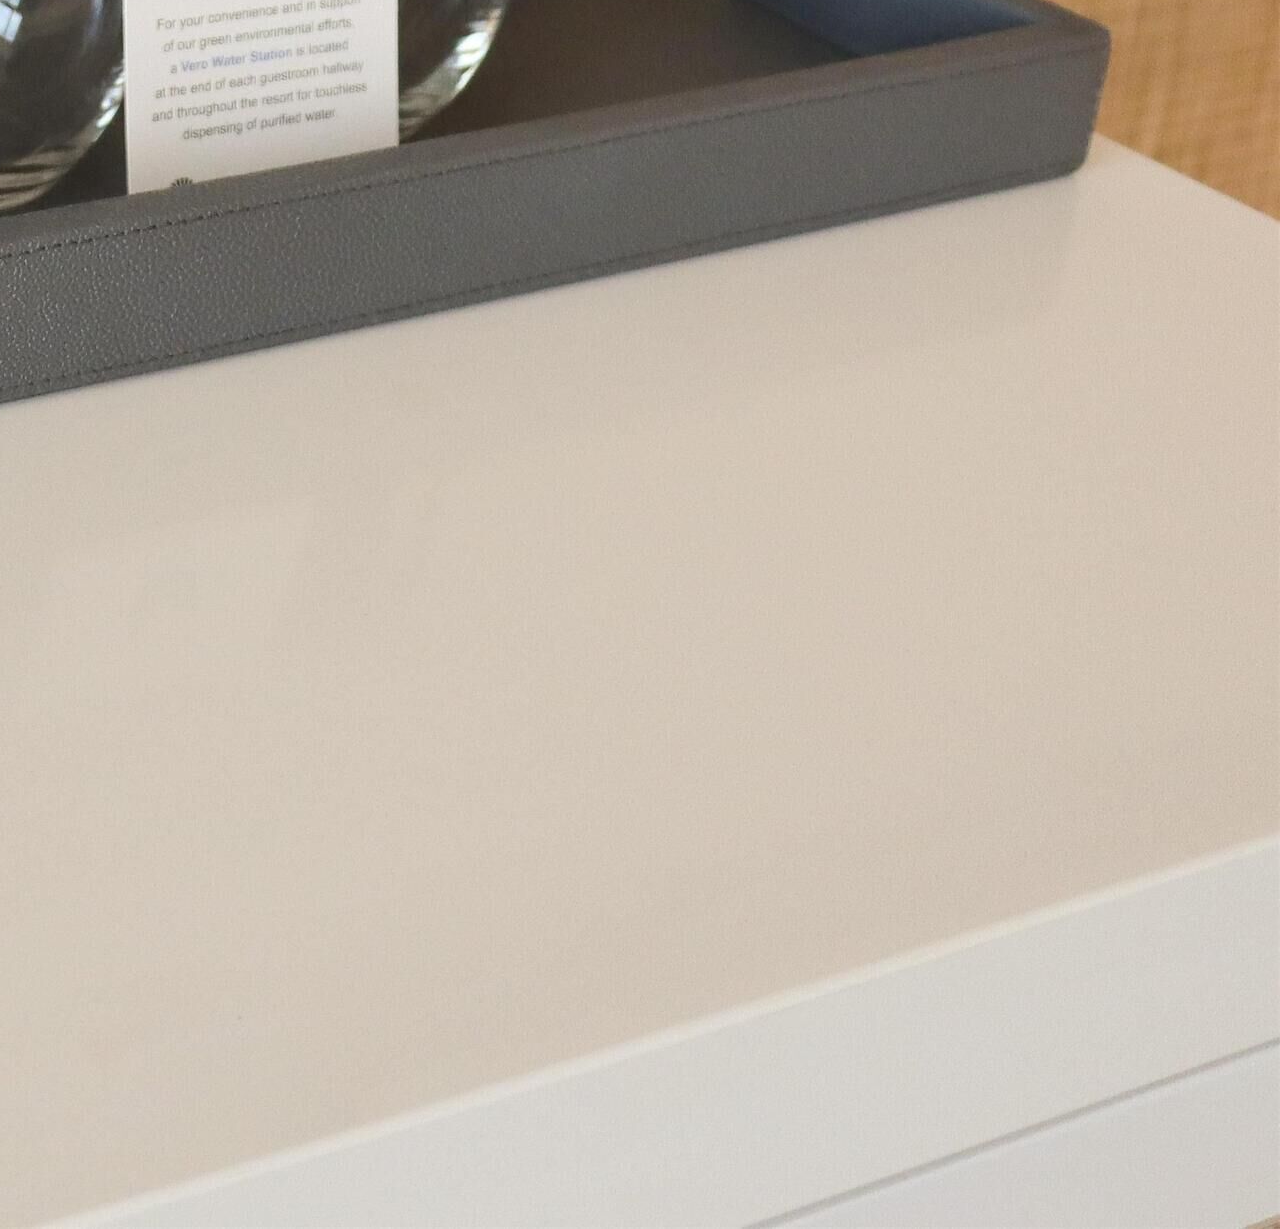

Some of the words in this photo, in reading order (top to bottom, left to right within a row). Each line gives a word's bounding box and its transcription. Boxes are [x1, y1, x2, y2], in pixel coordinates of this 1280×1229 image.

[157, 18, 176, 32] For
[179, 15, 204, 31] your
[208, 5, 279, 23] convenience
[282, 1, 303, 14] and
[307, 0, 316, 11] in
[164, 40, 175, 53] of
[177, 40, 196, 51] our
[199, 34, 232, 51] green
[235, 22, 313, 42] environmental
[170, 65, 177, 74] a
[181, 59, 208, 72] Vero
[212, 53, 246, 69] Water
[250, 48, 292, 63] Station
[296, 44, 304, 56] is
[308, 40, 349, 55] located
[155, 87, 166, 99] at
[170, 84, 187, 97] the
[190, 81, 211, 93] end
[215, 78, 225, 91] of
[229, 74, 257, 89] each
[260, 66, 319, 86] guestroom
[322, 60, 365, 77] hallway
[152, 110, 173, 123] and
[177, 99, 238, 120] throughout
[240, 97, 257, 109] the
[262, 92, 294, 106] resort
[297, 89, 312, 102] for
[315, 82, 368, 99] touchless
[183, 122, 243, 141] dispensing
[247, 117, 258, 131] of
[260, 112, 302, 131] purified
